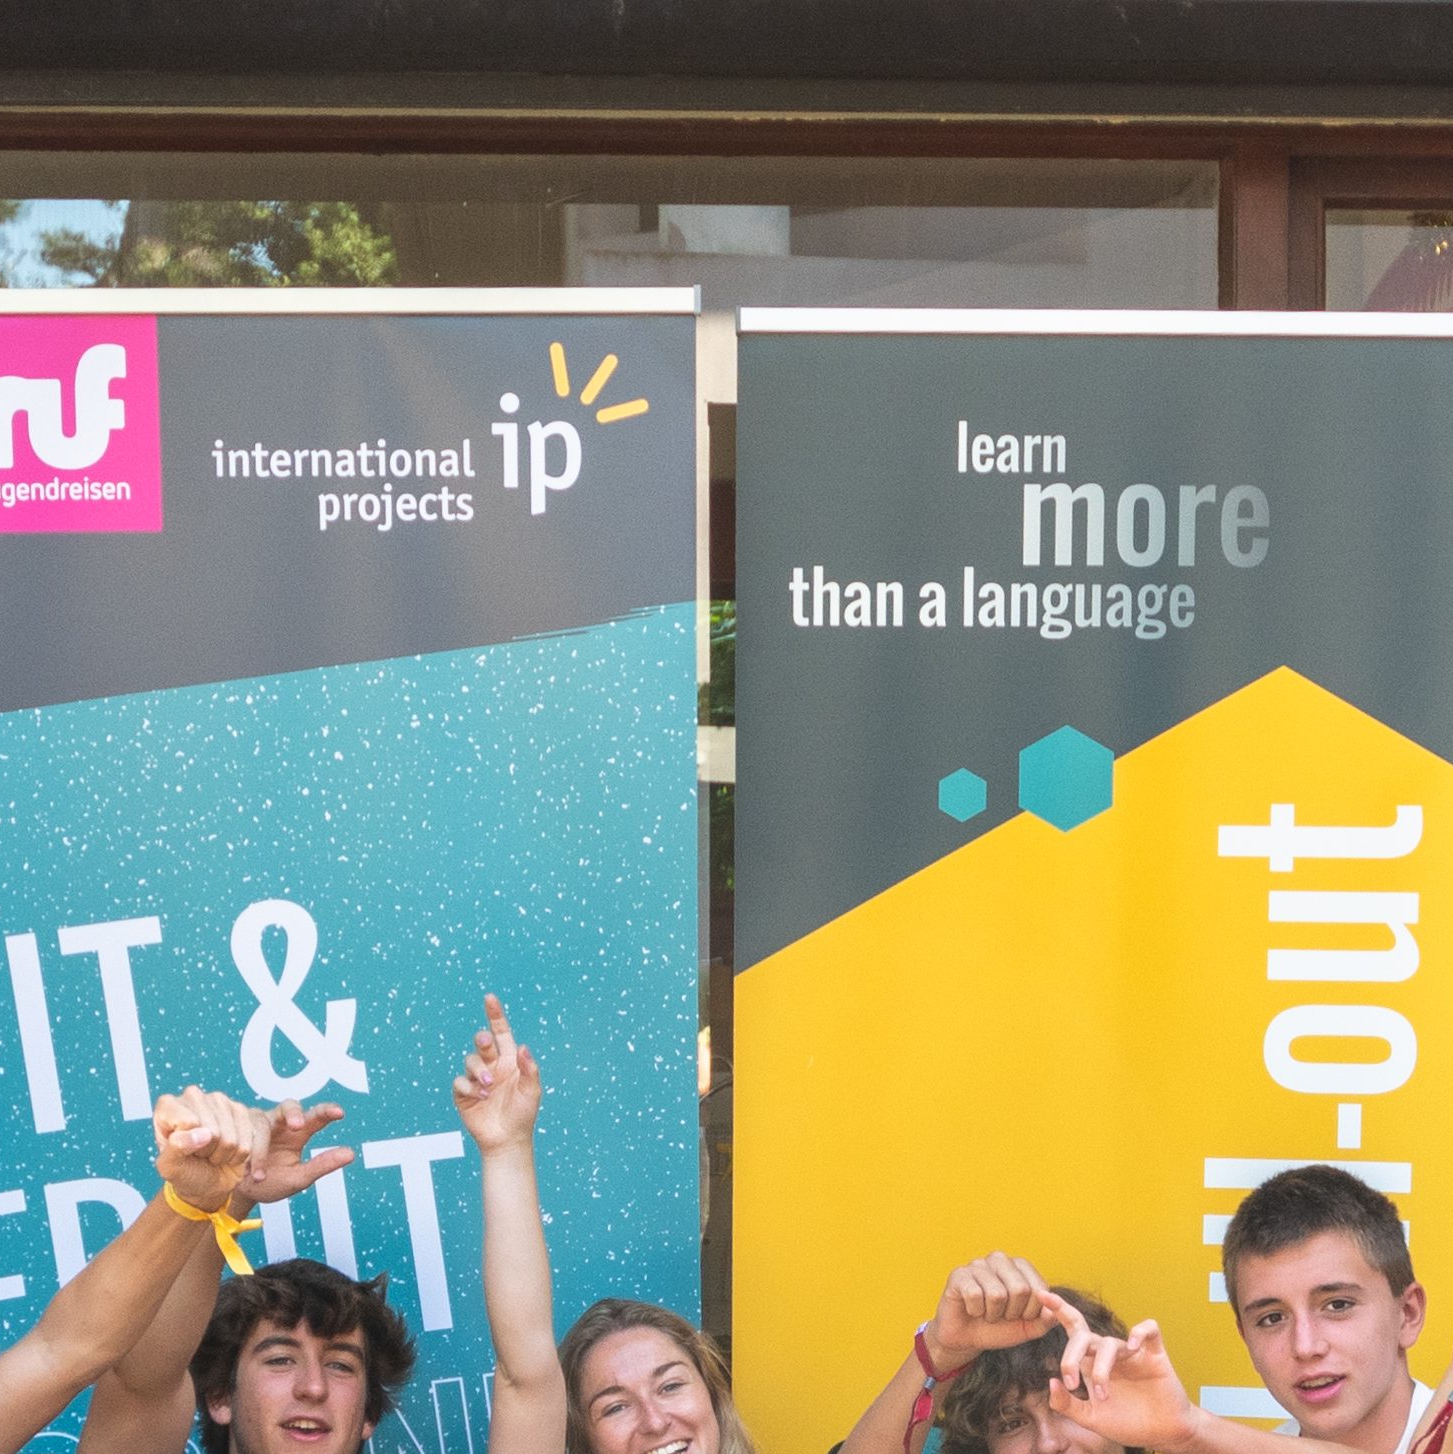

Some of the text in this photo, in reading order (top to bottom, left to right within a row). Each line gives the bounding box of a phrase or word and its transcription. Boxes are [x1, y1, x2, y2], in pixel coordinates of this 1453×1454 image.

[211, 438, 476, 478] international
[491, 392, 583, 516] ip
[957, 420, 1066, 474] learn
[318, 485, 474, 532] projects
[1022, 482, 1271, 568] more
[788, 565, 1196, 641] than a language
[229, 899, 369, 1103] &
